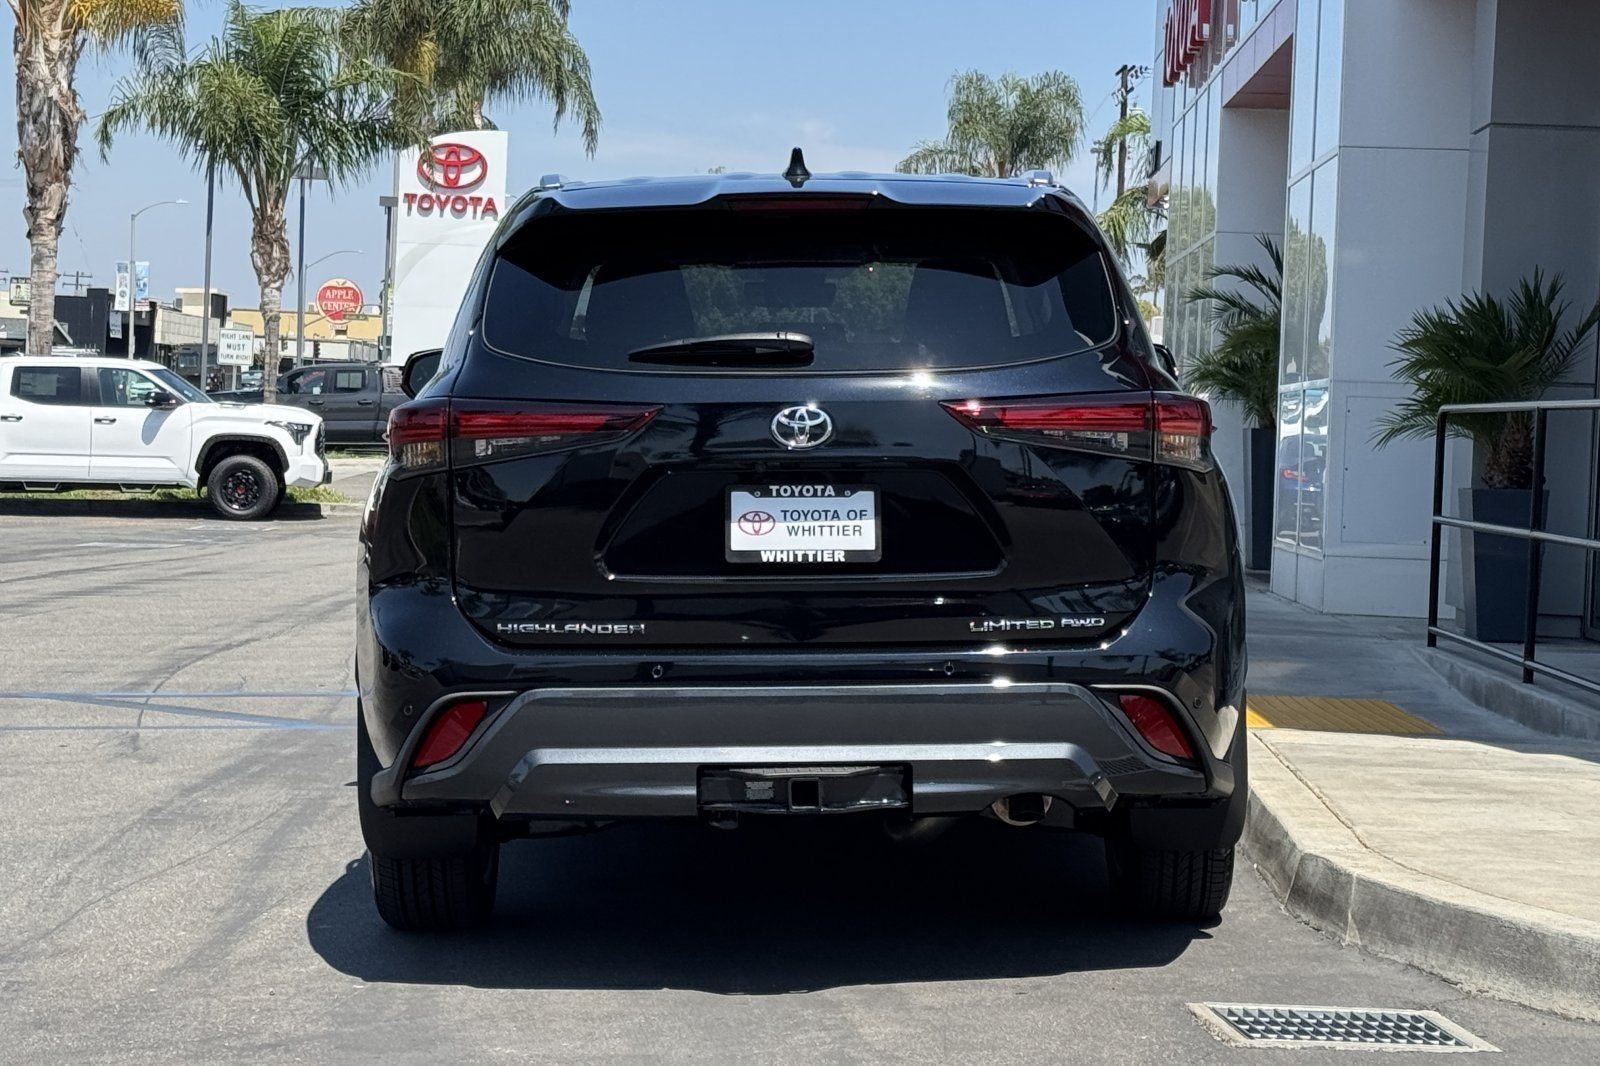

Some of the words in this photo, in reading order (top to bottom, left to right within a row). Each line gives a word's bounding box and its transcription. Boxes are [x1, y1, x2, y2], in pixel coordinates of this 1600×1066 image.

[403, 193, 499, 217] TOYOTA
[326, 289, 354, 300] APPLE
[226, 343, 246, 351] MUST
[769, 485, 835, 497] TOYOTA
[780, 509, 841, 522] TOYOTA
[846, 509, 868, 521] OF
[786, 524, 863, 537] WHITTIER
[760, 550, 846, 563] WHITTIER
[497, 622, 645, 634] HIGHLANDER
[969, 619, 1055, 633] LIMITED
[1060, 617, 1105, 628] AWD
